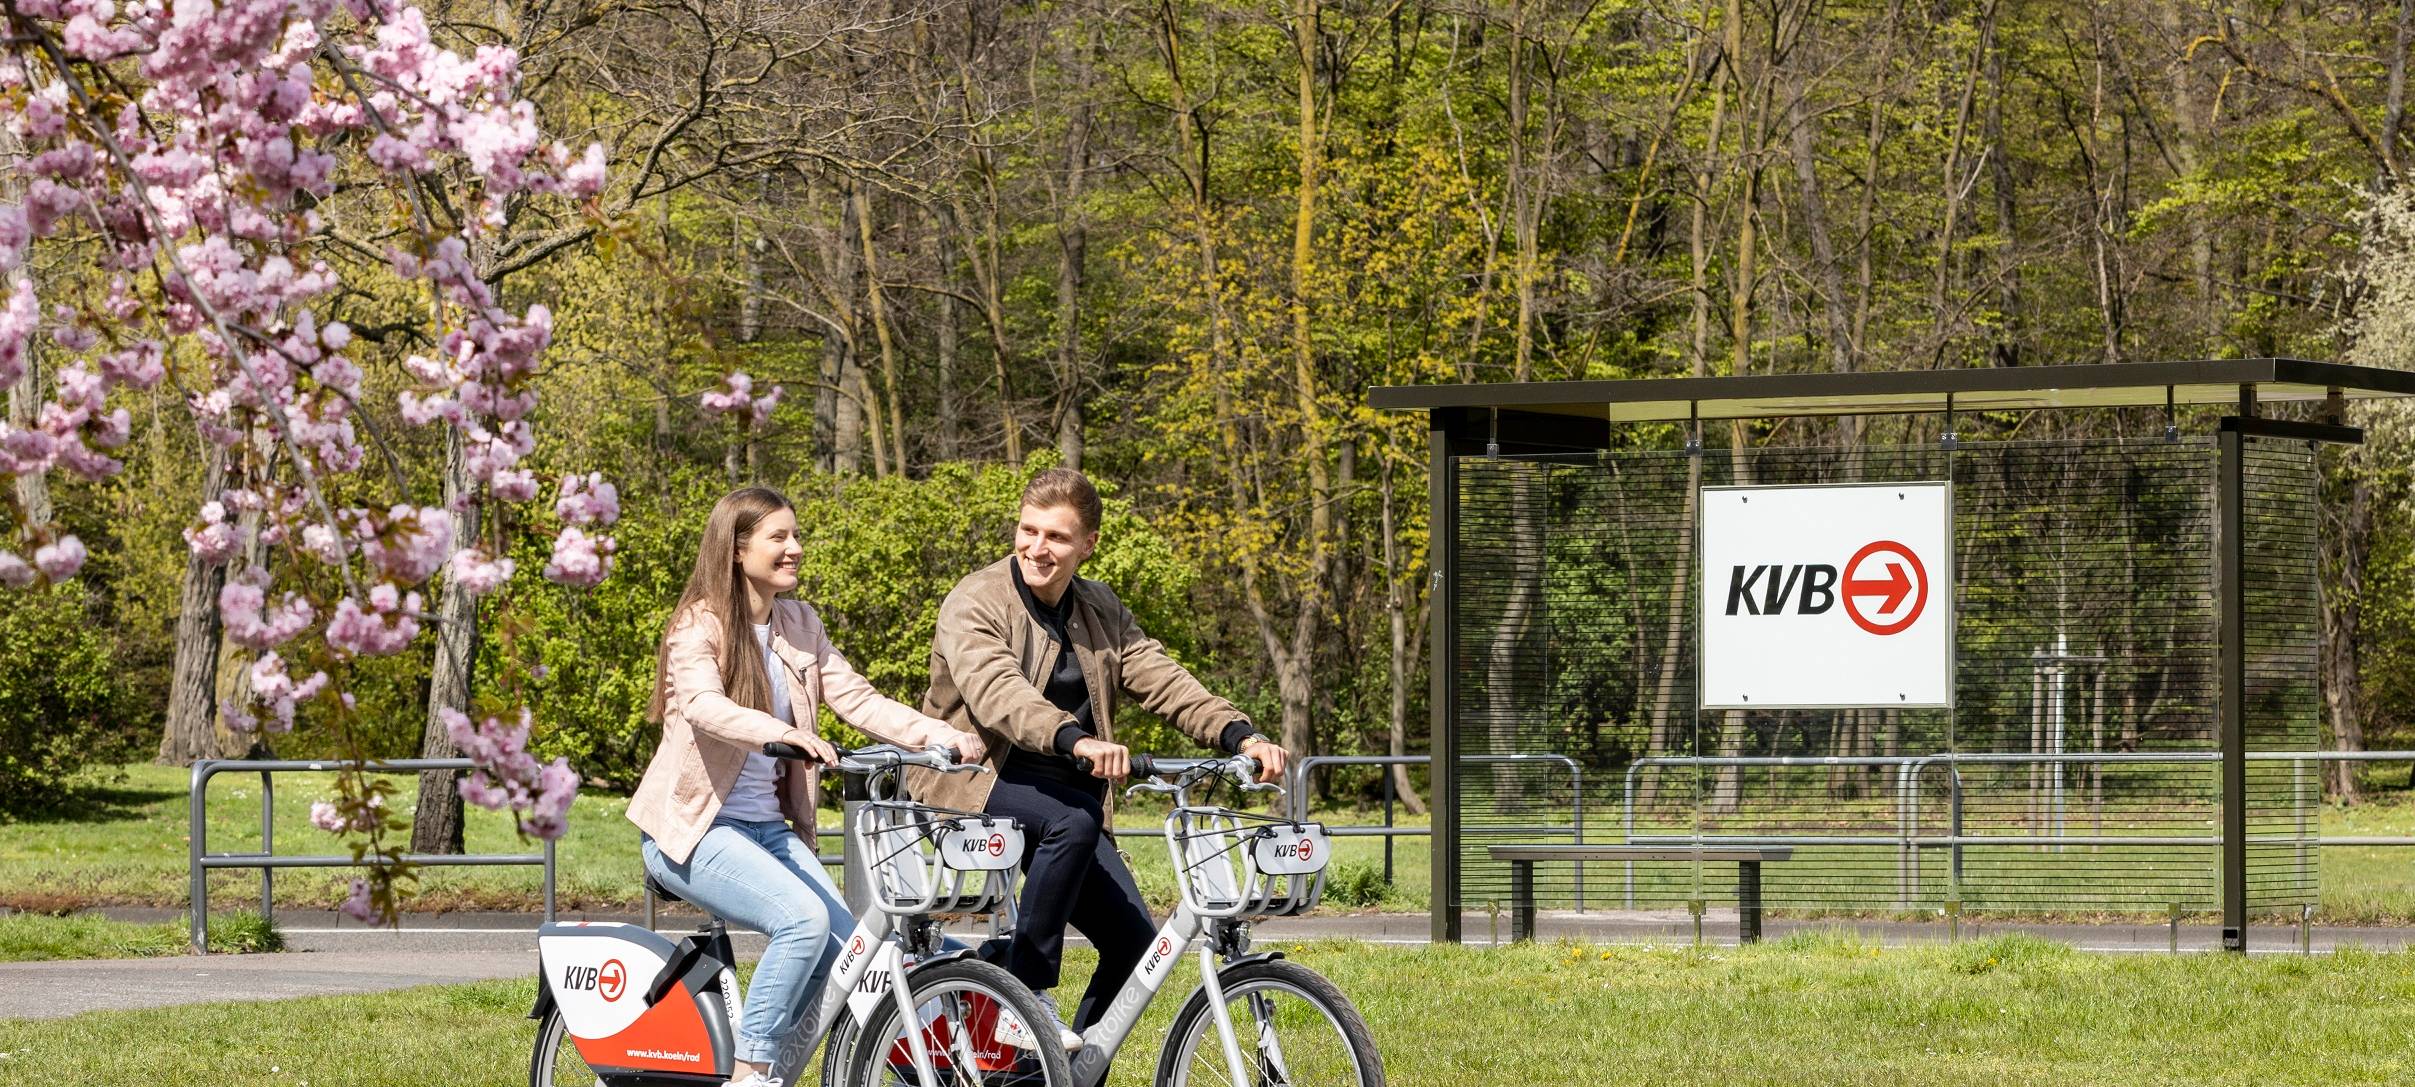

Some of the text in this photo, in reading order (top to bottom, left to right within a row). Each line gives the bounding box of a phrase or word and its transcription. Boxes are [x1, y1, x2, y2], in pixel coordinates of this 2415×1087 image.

[1725, 564, 1838, 616] KVB
[962, 839, 987, 852] KVB
[1274, 844, 1297, 857] KVB
[839, 950, 855, 975] KVB
[1144, 951, 1161, 975] KVB
[563, 965, 598, 991] KVB
[774, 985, 836, 1078] nextbike
[1074, 986, 1140, 1079] nextbike
[626, 1049, 700, 1062] www.kvb.koeln/rad
